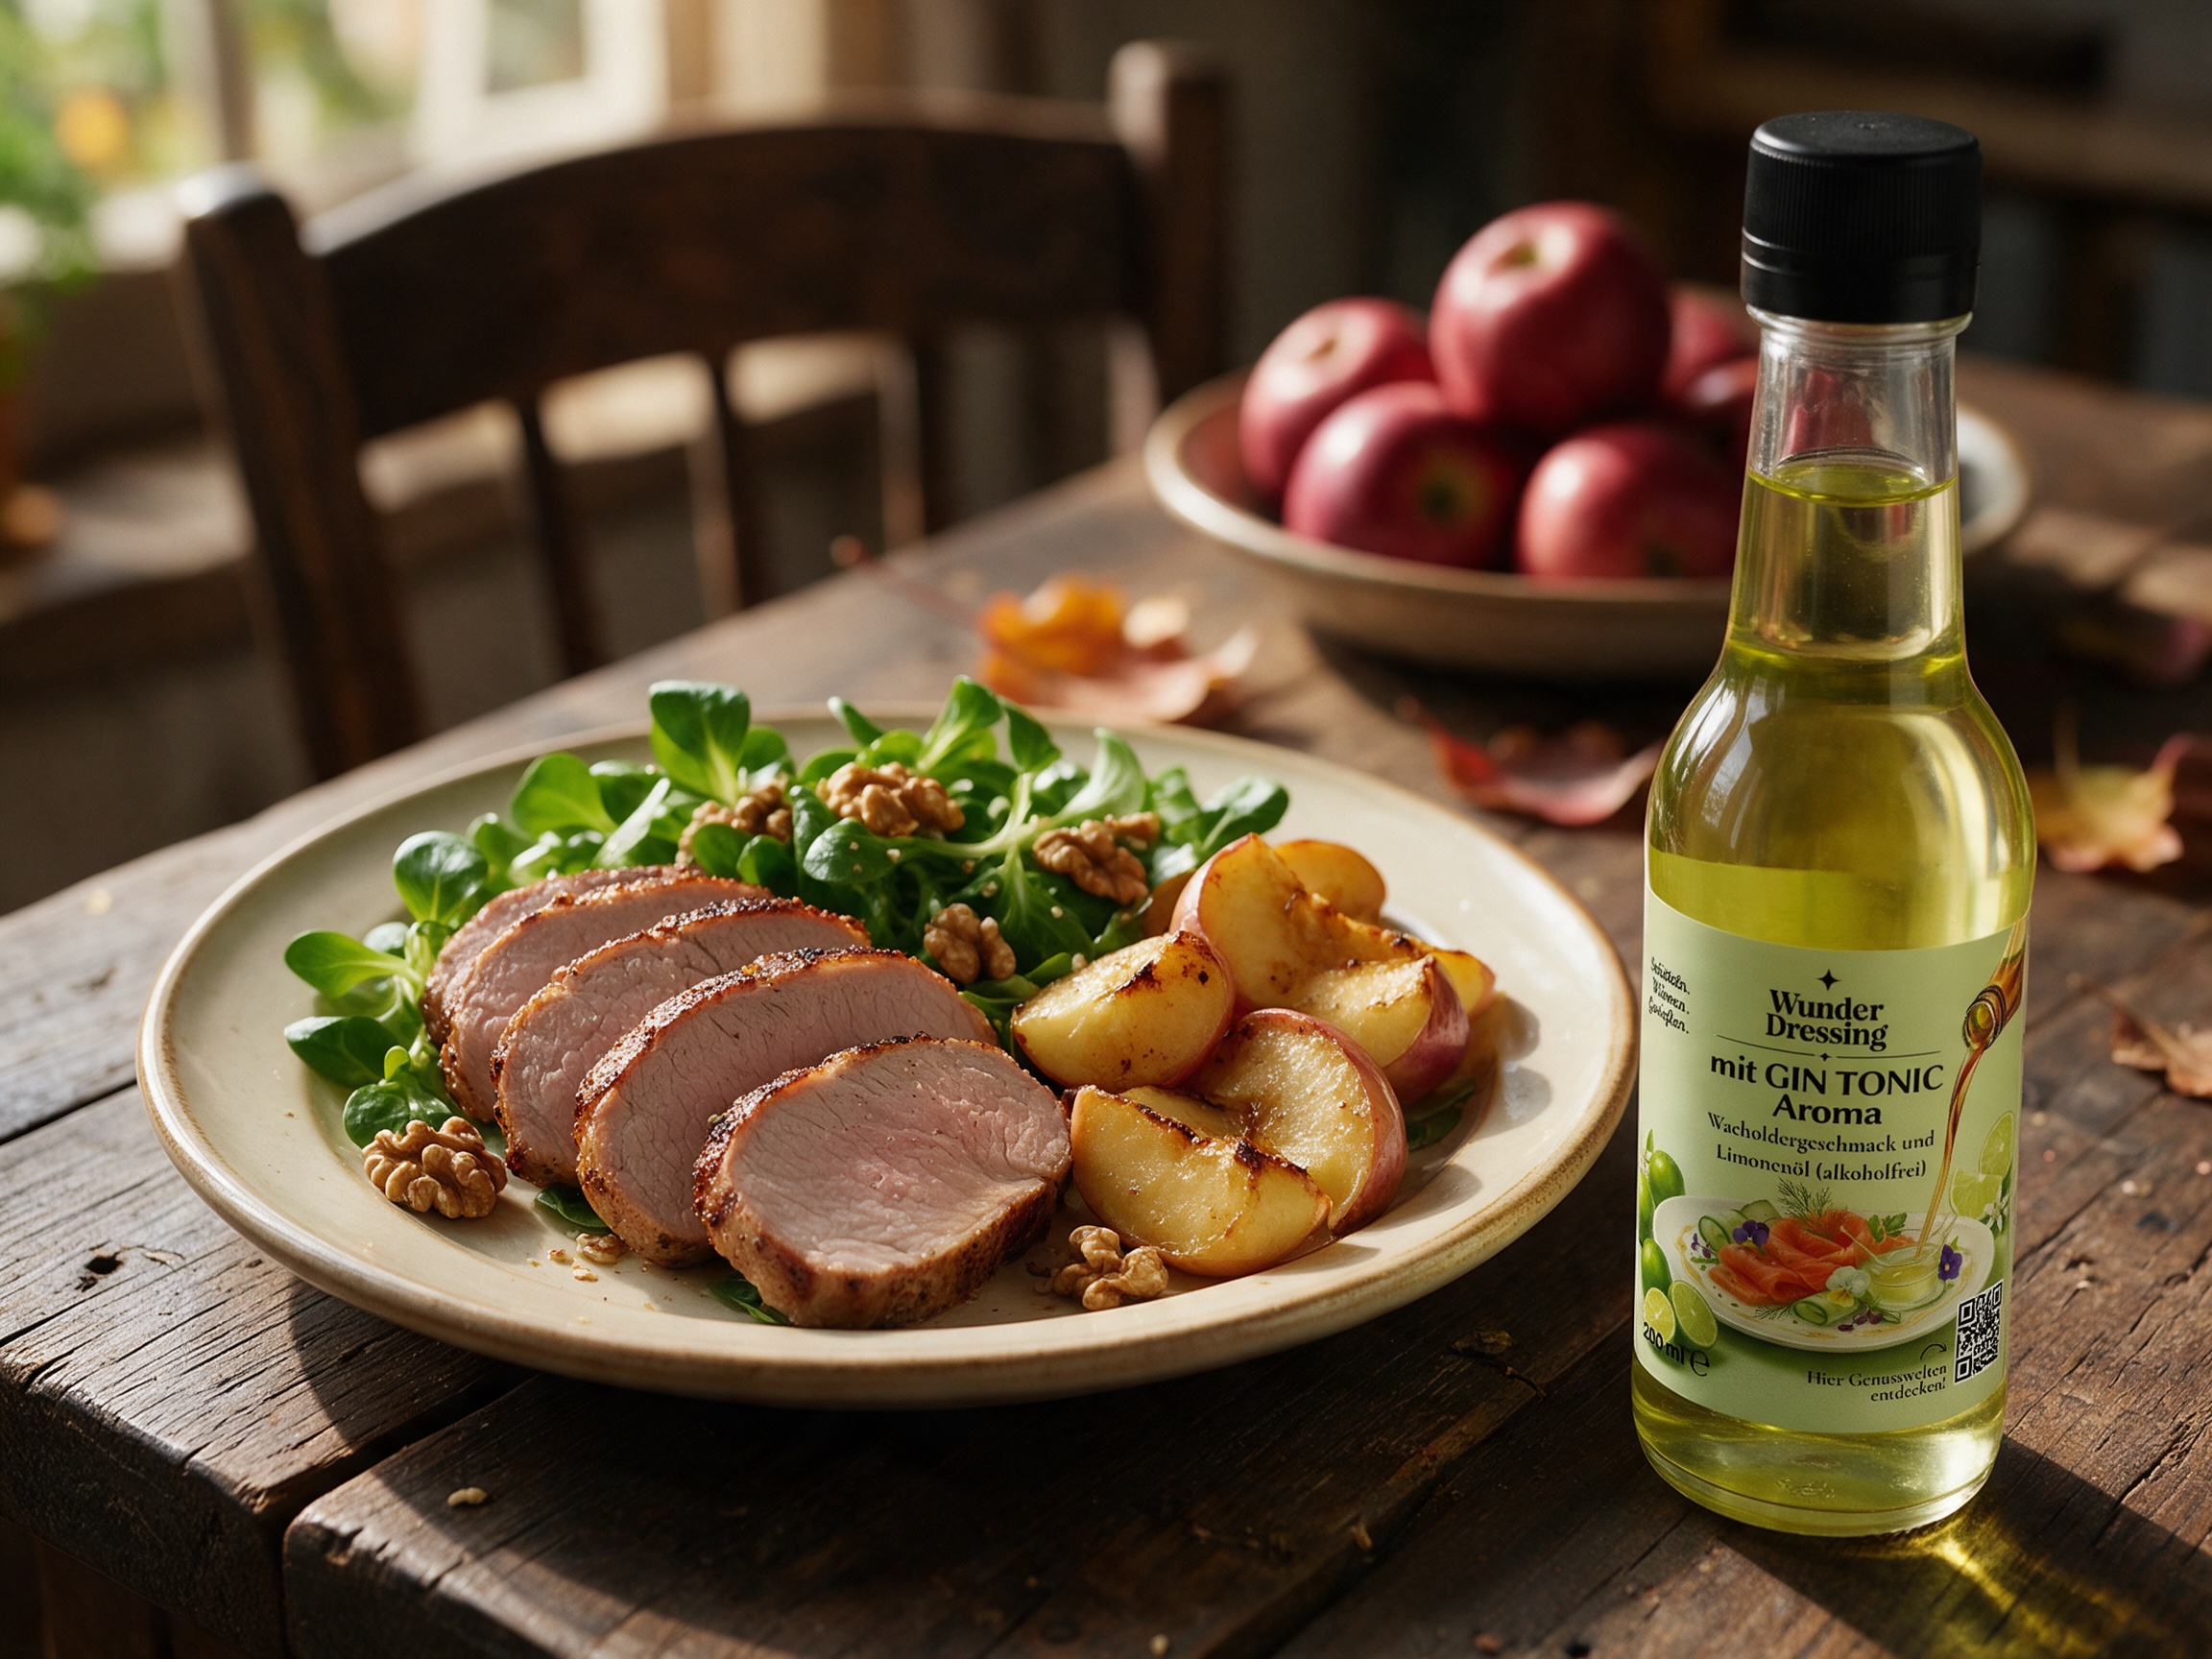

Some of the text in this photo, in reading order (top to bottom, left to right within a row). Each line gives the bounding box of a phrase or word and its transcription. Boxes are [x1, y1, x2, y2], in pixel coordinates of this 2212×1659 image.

[1769, 989, 1885, 1022] Wunder
[1765, 1013, 1888, 1051] Dressing
[1711, 1055, 1944, 1096] mit GIN TONIC
[1772, 1094, 1882, 1125] Aroma
[1708, 1112, 1935, 1154] Wacholdergeschmack und
[1717, 1143, 1927, 1182] Limonenöl (alkoholfrei)
[1644, 1322, 1664, 1351] 200
[1808, 1364, 1947, 1386] Hier Genusswelten
[1870, 1377, 1946, 1402] entdecken!
